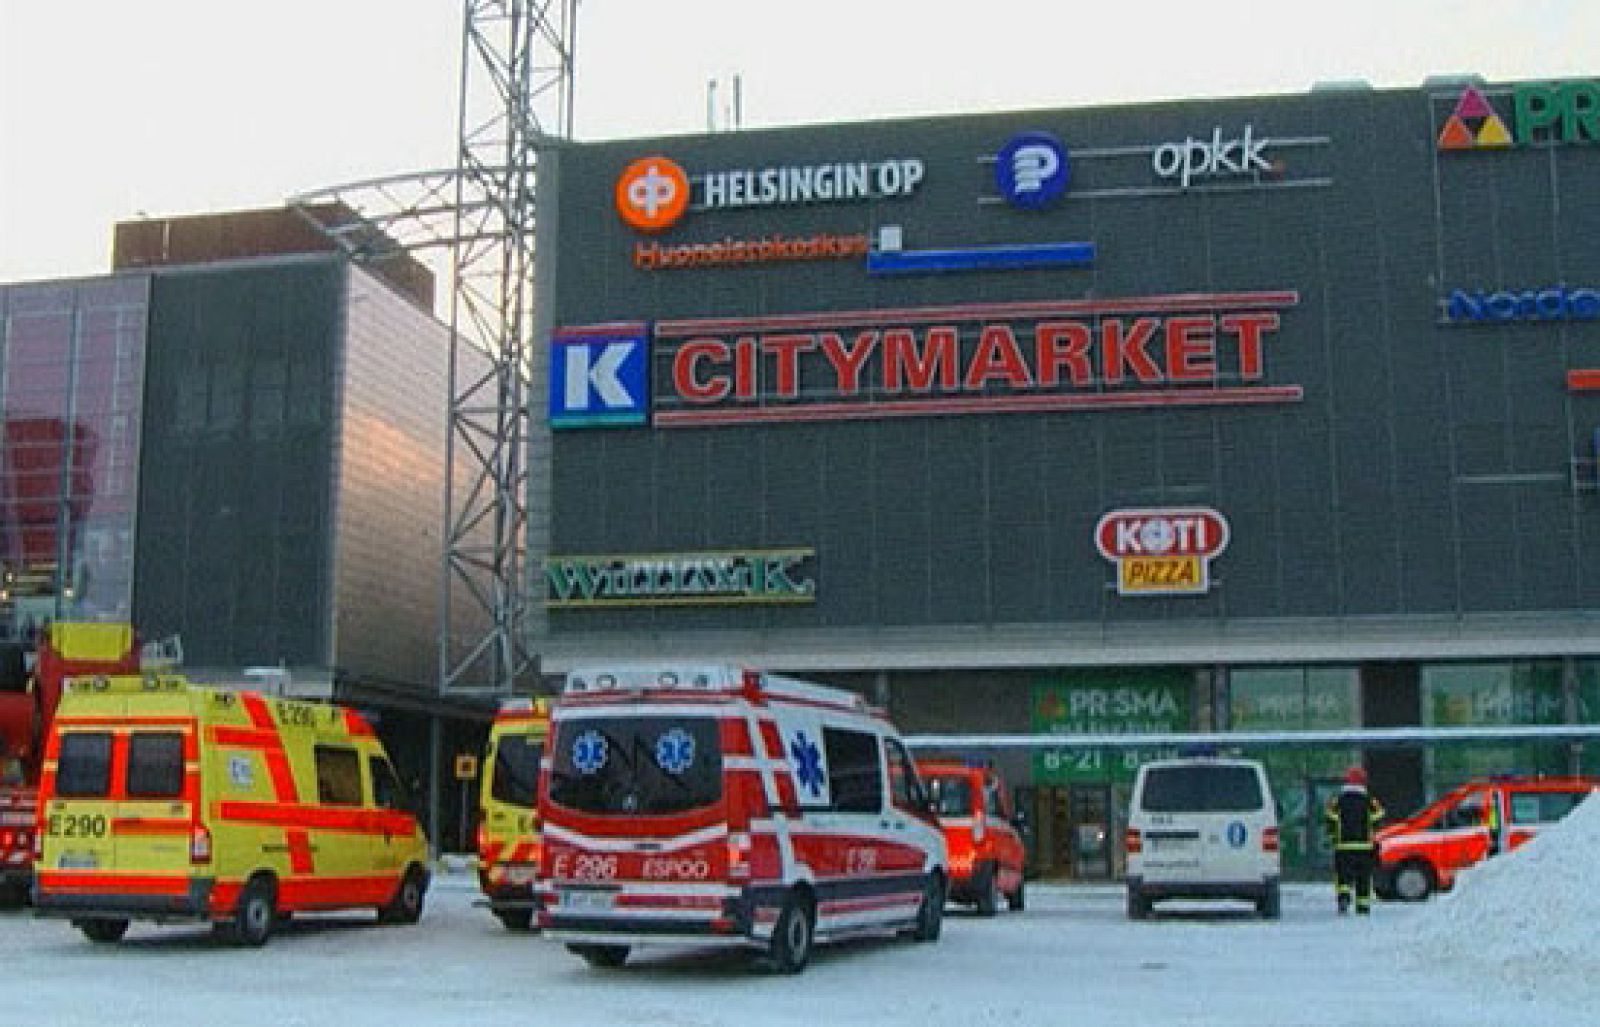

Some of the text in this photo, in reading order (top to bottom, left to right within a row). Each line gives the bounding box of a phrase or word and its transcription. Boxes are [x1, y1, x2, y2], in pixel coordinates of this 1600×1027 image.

[1513, 80, 1600, 143] PR
[704, 158, 924, 208] HELSINGIN OP
[561, 312, 1281, 411] K CITYMARKET
[1115, 516, 1207, 554] KOTI
[1127, 559, 1196, 586] PIZZA
[1069, 687, 1180, 718] PRSMA
[48, 813, 107, 838] E290
[553, 854, 571, 878] E
[642, 857, 710, 880] ESPOO
